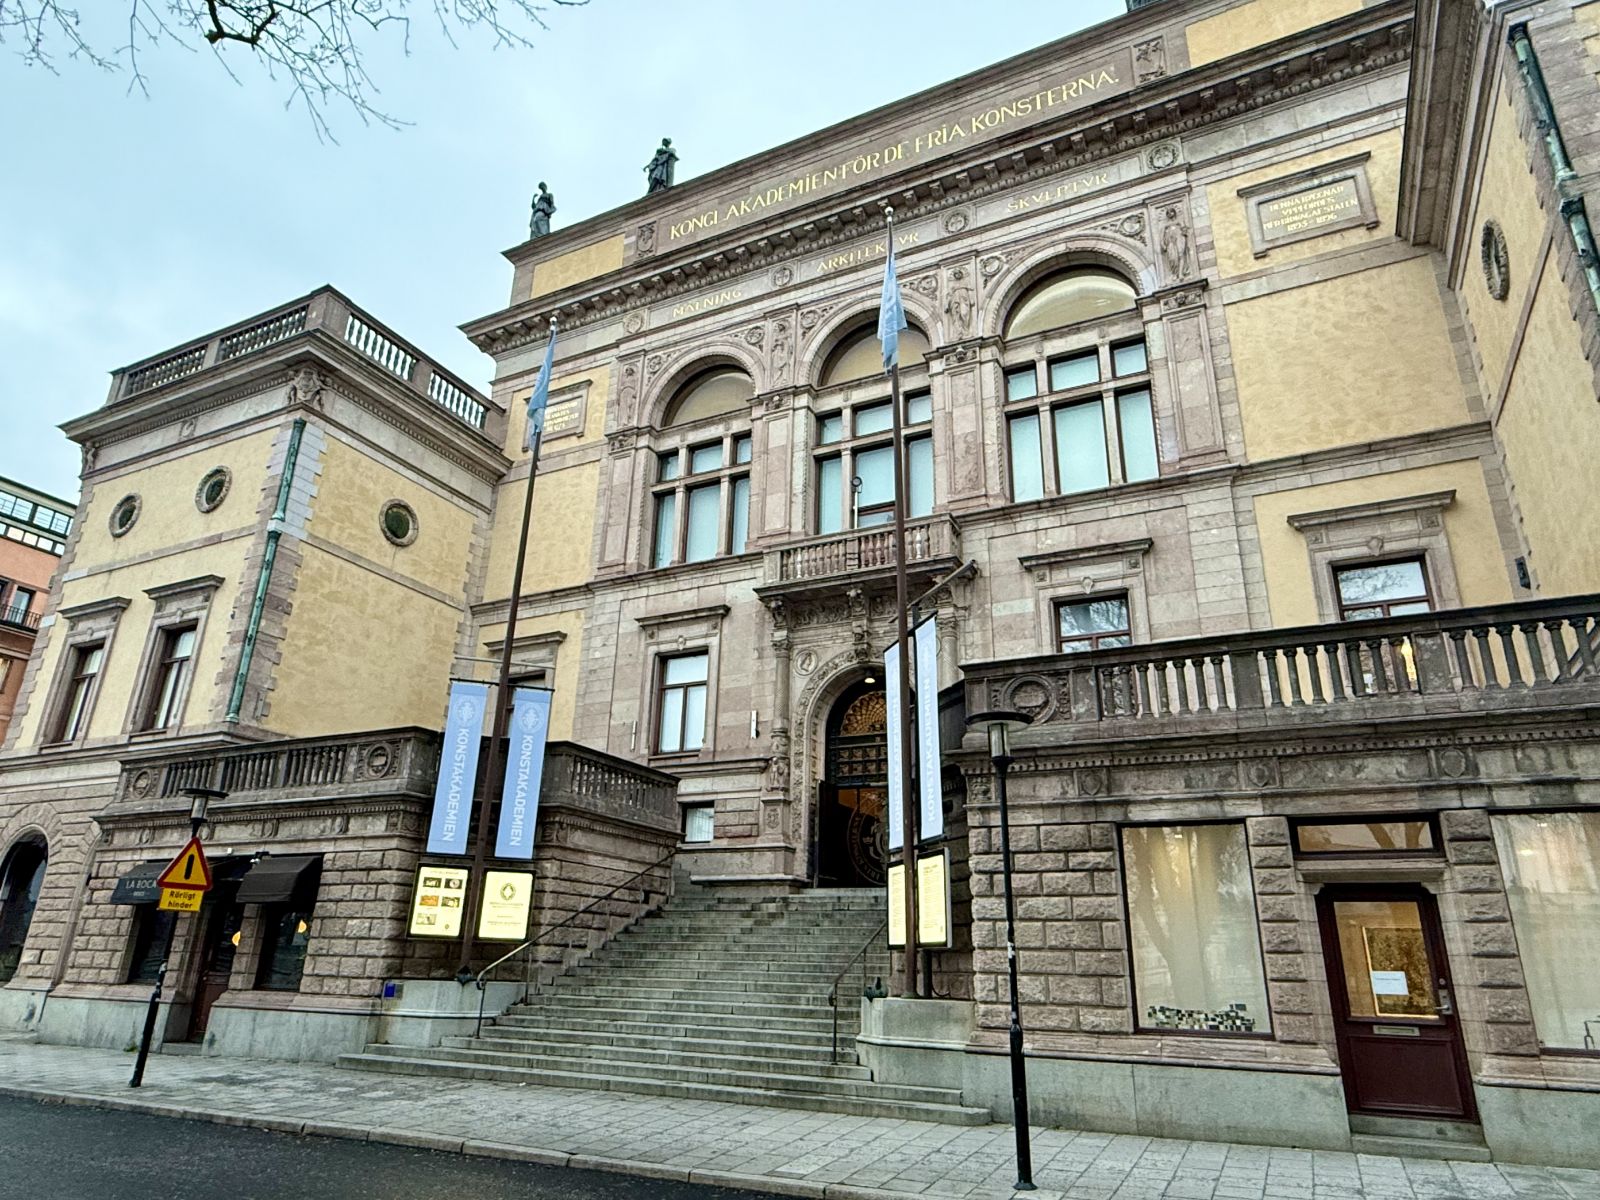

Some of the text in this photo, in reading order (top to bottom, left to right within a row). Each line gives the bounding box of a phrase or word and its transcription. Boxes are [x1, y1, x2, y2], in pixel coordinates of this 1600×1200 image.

[841, 153, 880, 179] FÖR
[884, 141, 909, 164] DE
[915, 124, 966, 153] FRIA
[442, 728, 470, 842] KONSTAKADEMIEN
[509, 734, 534, 846] KONSTAKADEMIEN
[125, 880, 135, 889] LA
[168, 890, 196, 900] Rörligt
[167, 901, 193, 909] hinder
